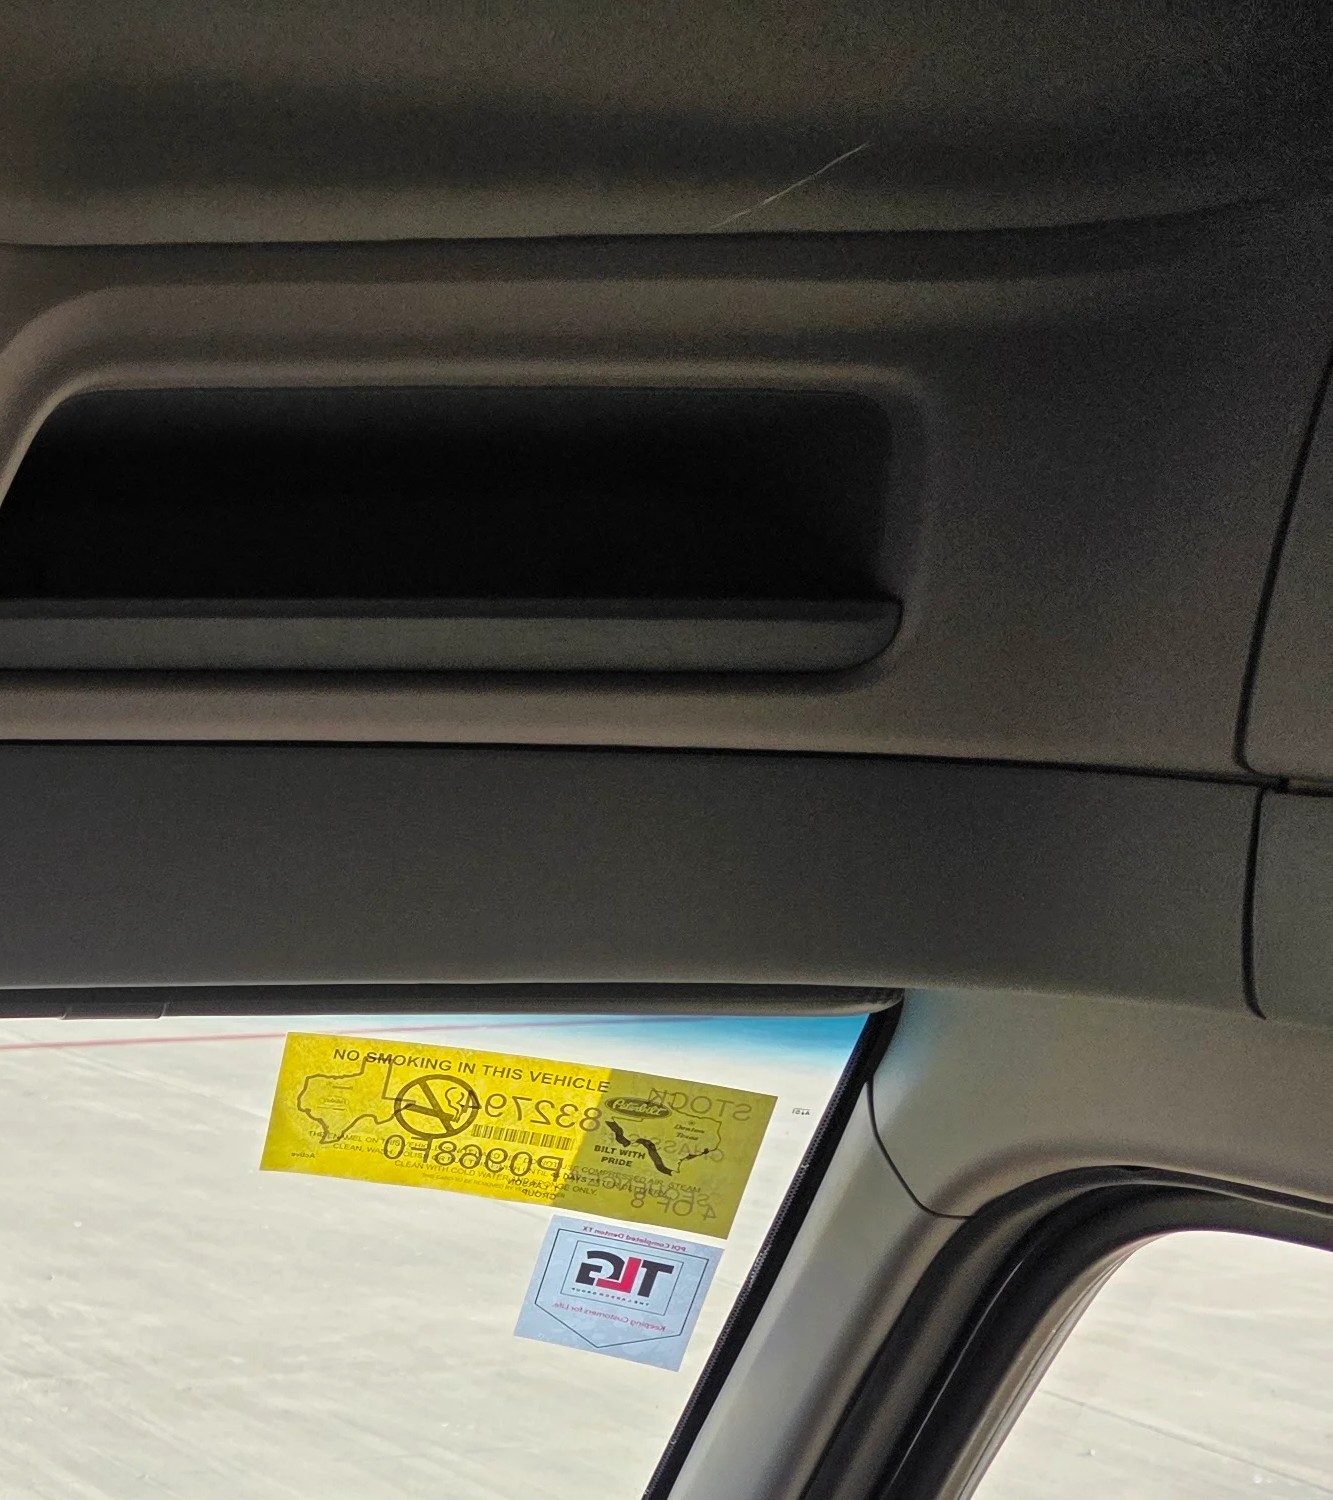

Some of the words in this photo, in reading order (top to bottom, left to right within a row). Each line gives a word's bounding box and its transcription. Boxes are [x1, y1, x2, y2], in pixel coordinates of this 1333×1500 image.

[333, 1049, 360, 1061] NO
[366, 1052, 452, 1071] SMOKING
[458, 1062, 476, 1074] IN
[483, 1064, 523, 1080] THIS
[529, 1070, 611, 1093] VEHICLE
[612, 1100, 668, 1117] Peterbilt
[365, 1136, 379, 1144] ON
[594, 1145, 621, 1157] BILT
[622, 1148, 646, 1160] WITH
[601, 1156, 633, 1168] PRIDE
[395, 1160, 423, 1170] CLEAN
[426, 1164, 447, 1172] WITH
[451, 1166, 475, 1176] COLD
[478, 1170, 509, 1181] WATER
